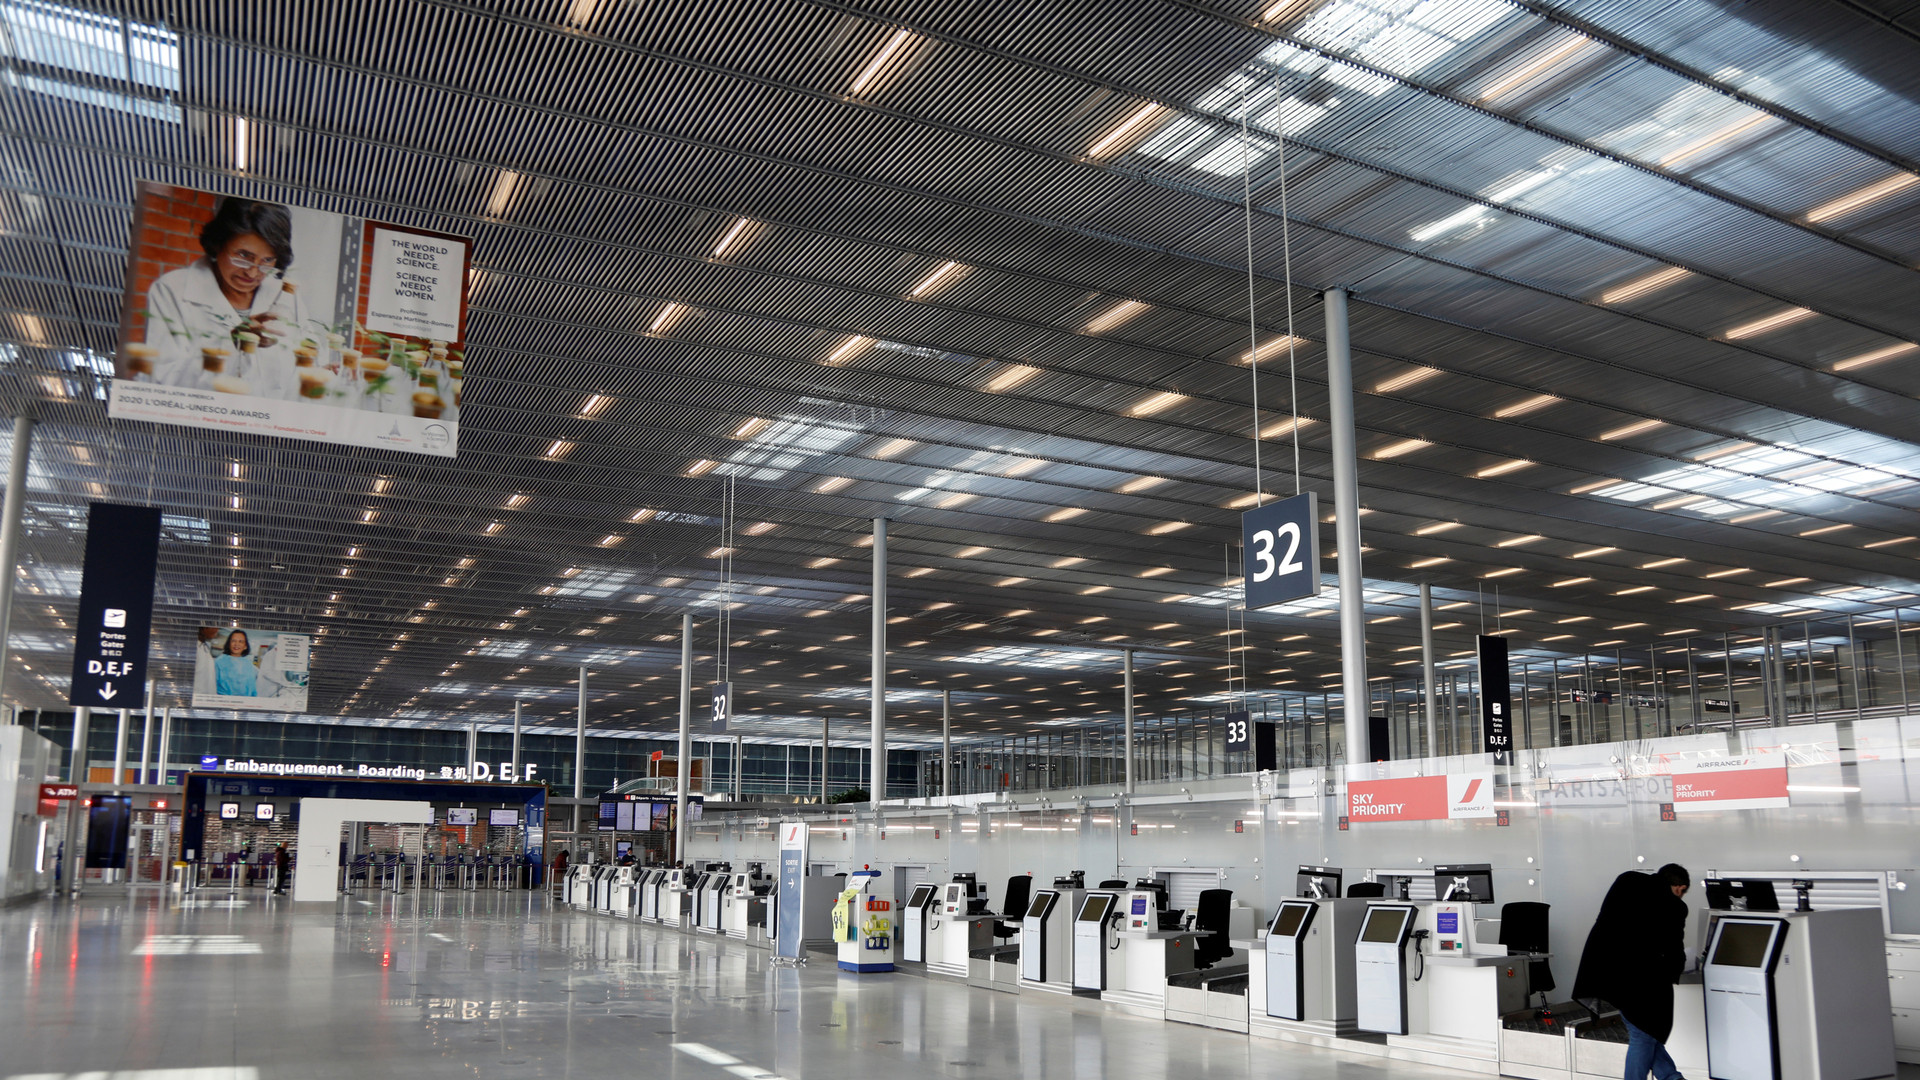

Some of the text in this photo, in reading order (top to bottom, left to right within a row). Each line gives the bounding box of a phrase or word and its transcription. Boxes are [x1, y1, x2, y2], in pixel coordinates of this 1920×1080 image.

[392, 239, 448, 255] THE WORLD
[403, 250, 435, 261] NEEDS
[396, 257, 440, 271] SCIENCE.
[396, 271, 438, 285] SCIENCE
[400, 281, 432, 292] NEEDS
[394, 288, 436, 301] WOMEN.
[371, 311, 402, 321] Esperanza
[400, 308, 428, 317] Professor
[153, 388, 167, 396] FOR
[187, 392, 215, 401] AMERICA
[118, 395, 143, 405] 2020
[230, 409, 271, 420] AWARDS
[1253, 521, 1303, 583] 32
[100, 632, 126, 640] Portes
[101, 640, 124, 649] Gates
[713, 694, 726, 721] 32
[1228, 721, 1247, 743] 33
[225, 759, 343, 776] Embarquement
[358, 764, 425, 781] Boarding
[439, 766, 467, 780] 登机
[57, 788, 78, 796] ATM
[1676, 790, 1716, 798] PRIORITY
[1352, 793, 1374, 805] SKY
[1353, 803, 1403, 816] PRIORITY
[1662, 811, 1674, 820] 02
[1498, 817, 1508, 825] 03
